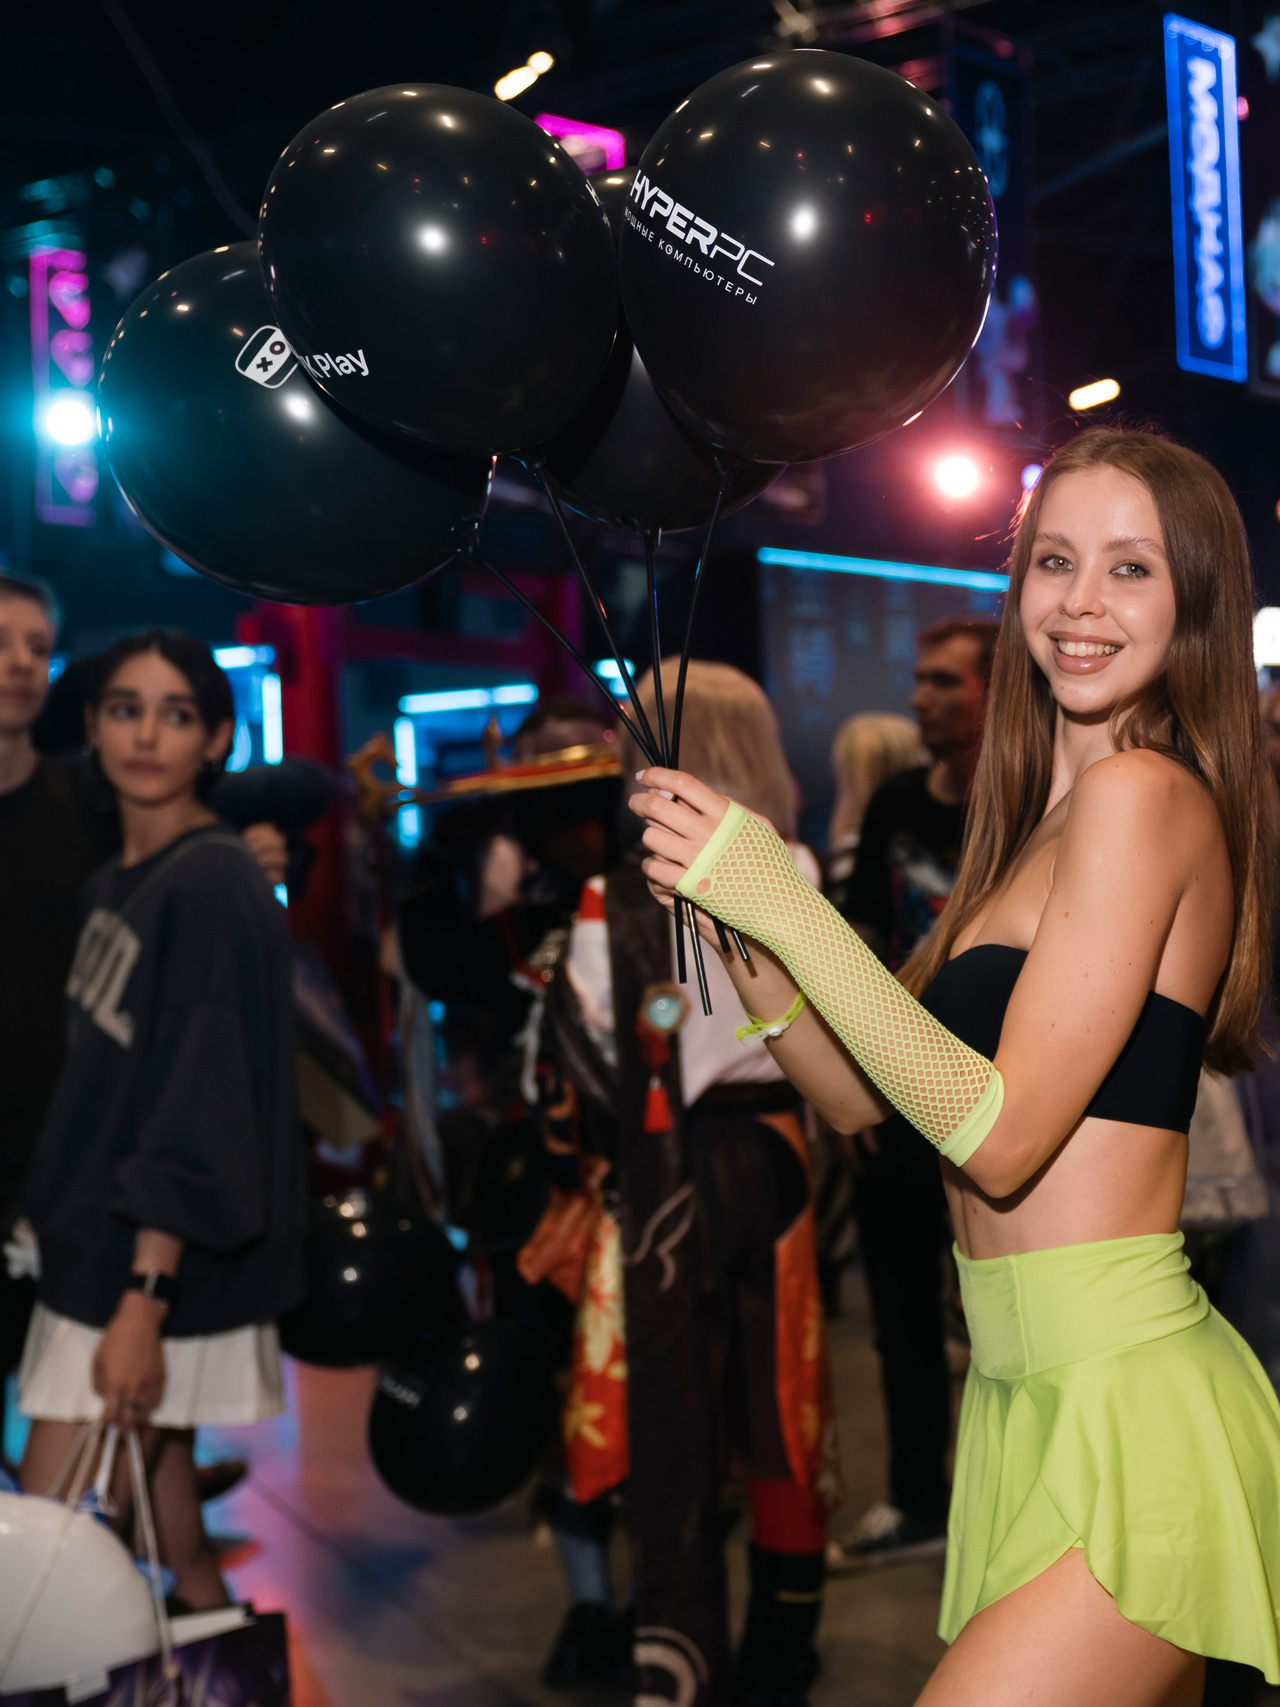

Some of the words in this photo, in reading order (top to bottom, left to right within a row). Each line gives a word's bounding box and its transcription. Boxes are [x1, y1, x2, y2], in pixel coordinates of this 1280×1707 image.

[630, 169, 775, 286] HYPERPC
[658, 238, 757, 305] КОМПЬЮТЕРЫ
[312, 349, 369, 378] Play
